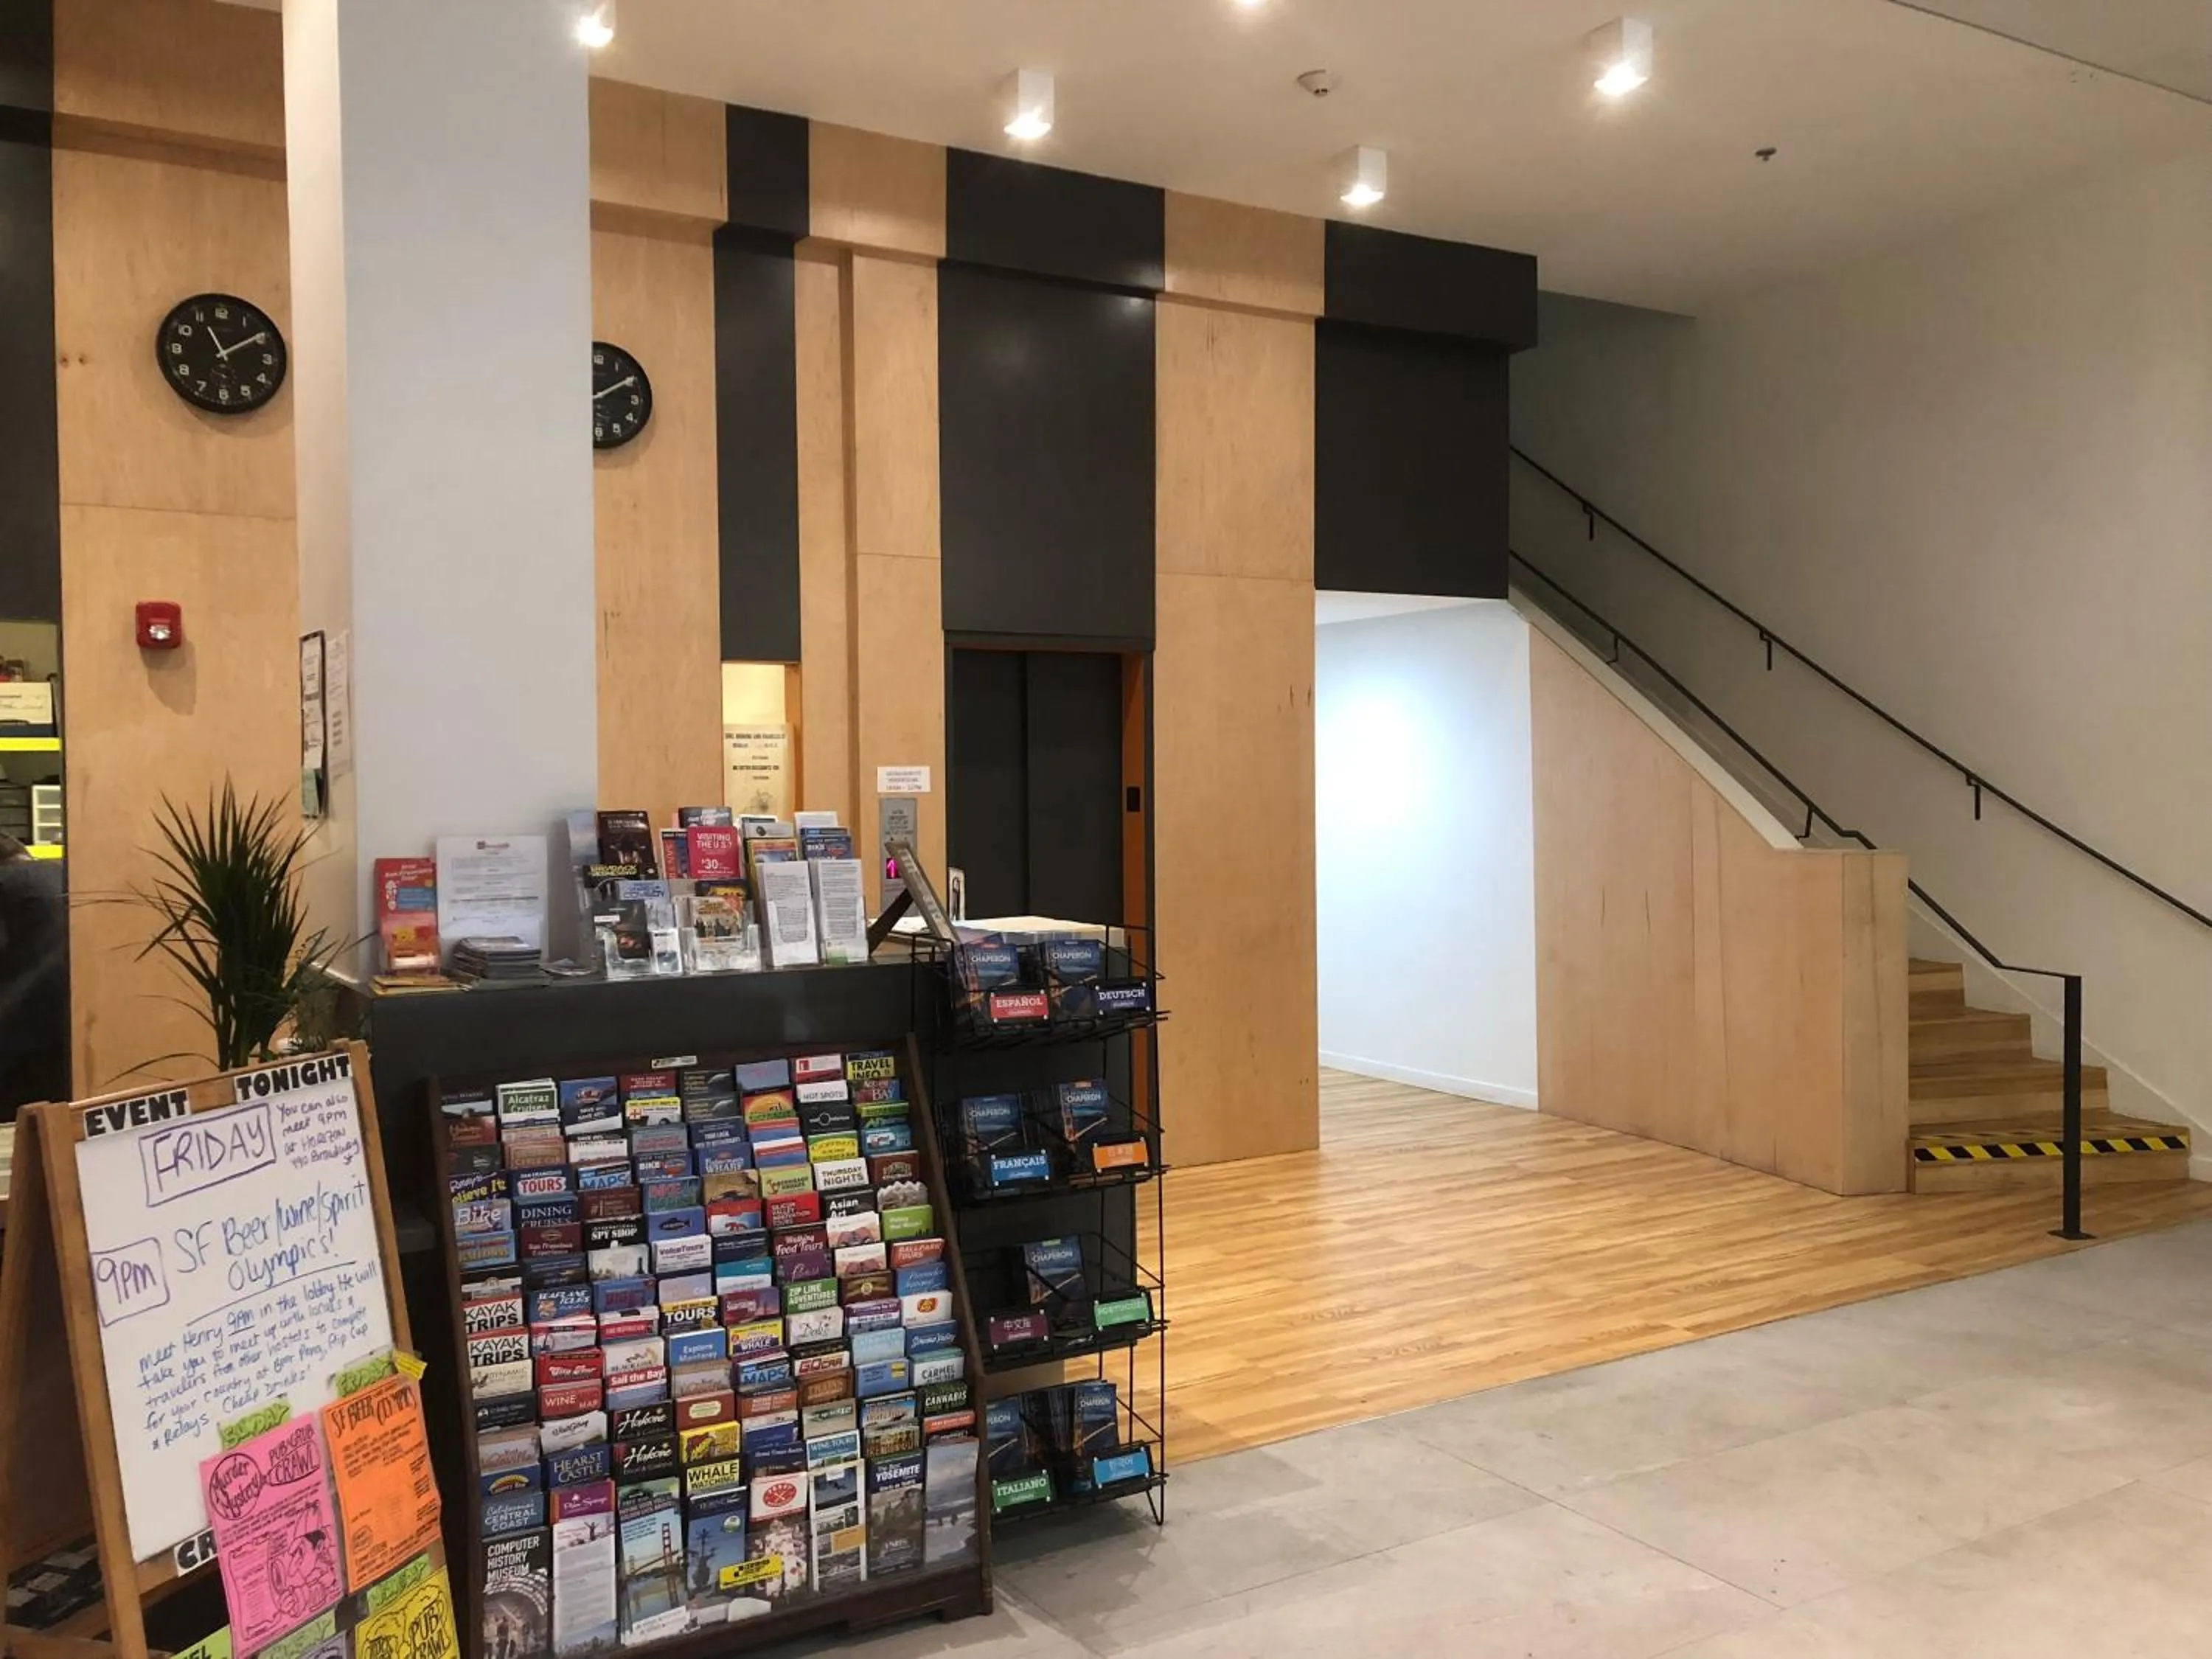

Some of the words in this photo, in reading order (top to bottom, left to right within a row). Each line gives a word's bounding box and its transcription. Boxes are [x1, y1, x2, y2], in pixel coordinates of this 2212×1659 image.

[195, 311, 204, 322] 11
[178, 324, 192, 336] 10
[262, 354, 272, 365] 3
[179, 364, 189, 375] 8
[257, 372, 266, 383] 4
[196, 380, 207, 392] 7
[240, 385, 251, 396] 5
[219, 389, 229, 400] 6
[996, 996, 1043, 1008] ESPAÑOL
[1099, 990, 1145, 1001] DEUTSCH
[851, 1059, 890, 1070] TRAVEL
[853, 1070, 880, 1079] INFO
[85, 1091, 187, 1137] EVENT
[236, 1056, 349, 1100] TONIGHT
[508, 1094, 549, 1104] Alcatraz
[153, 1115, 266, 1192] FRIDAY
[993, 1156, 1046, 1170] FRANÇAIS
[821, 1166, 862, 1176] THURSDAY
[522, 1180, 563, 1193] TOURS
[824, 1175, 863, 1186] NIGHTS
[521, 1206, 571, 1218] DINING
[830, 1199, 859, 1211] Asian
[455, 1204, 502, 1227] Bike
[591, 1229, 608, 1240] SPY
[611, 1228, 638, 1238] SHOP
[174, 1220, 213, 1273] SF
[776, 1244, 798, 1256] Food
[803, 1284, 821, 1292] LINE
[789, 1291, 836, 1304] ADVENTURES
[182, 1326, 223, 1354] Henry
[260, 1303, 272, 1318] in
[276, 1293, 298, 1313] the
[303, 1279, 335, 1301] lobby
[355, 1261, 378, 1284] will
[465, 1300, 517, 1321] KAYAK
[666, 1307, 715, 1324] TOURS
[465, 1313, 518, 1334] TRIPS
[470, 1336, 524, 1354] KAYAK
[684, 1344, 713, 1354] Explore
[740, 1340, 771, 1349] WHALE
[137, 1366, 175, 1388] take
[183, 1355, 206, 1378] you
[229, 1332, 260, 1354] meet
[471, 1349, 524, 1367] TRIPS
[611, 1374, 627, 1385] Sail
[630, 1371, 645, 1382] the
[744, 1369, 787, 1384] MAPS
[922, 1366, 956, 1379] CARMEL
[145, 1372, 206, 1408] travelers
[545, 1395, 577, 1407] WINE
[925, 1391, 967, 1407] CANNABIS
[144, 1411, 166, 1430] for
[275, 1444, 319, 1484] CRAWL
[554, 1450, 604, 1472] HEARST
[558, 1462, 603, 1483] CASTLE
[688, 1463, 738, 1482] WHALE
[876, 1464, 921, 1482] YOSEMITE
[692, 1476, 735, 1489] WATCHING
[997, 1478, 1047, 1496] ITALIANO
[484, 1509, 537, 1526] CENTRAL
[492, 1517, 529, 1532] COAST
[488, 1536, 539, 1557] COMPUTER
[488, 1551, 527, 1570] HISTORY
[488, 1562, 529, 1583] MUSEUM
